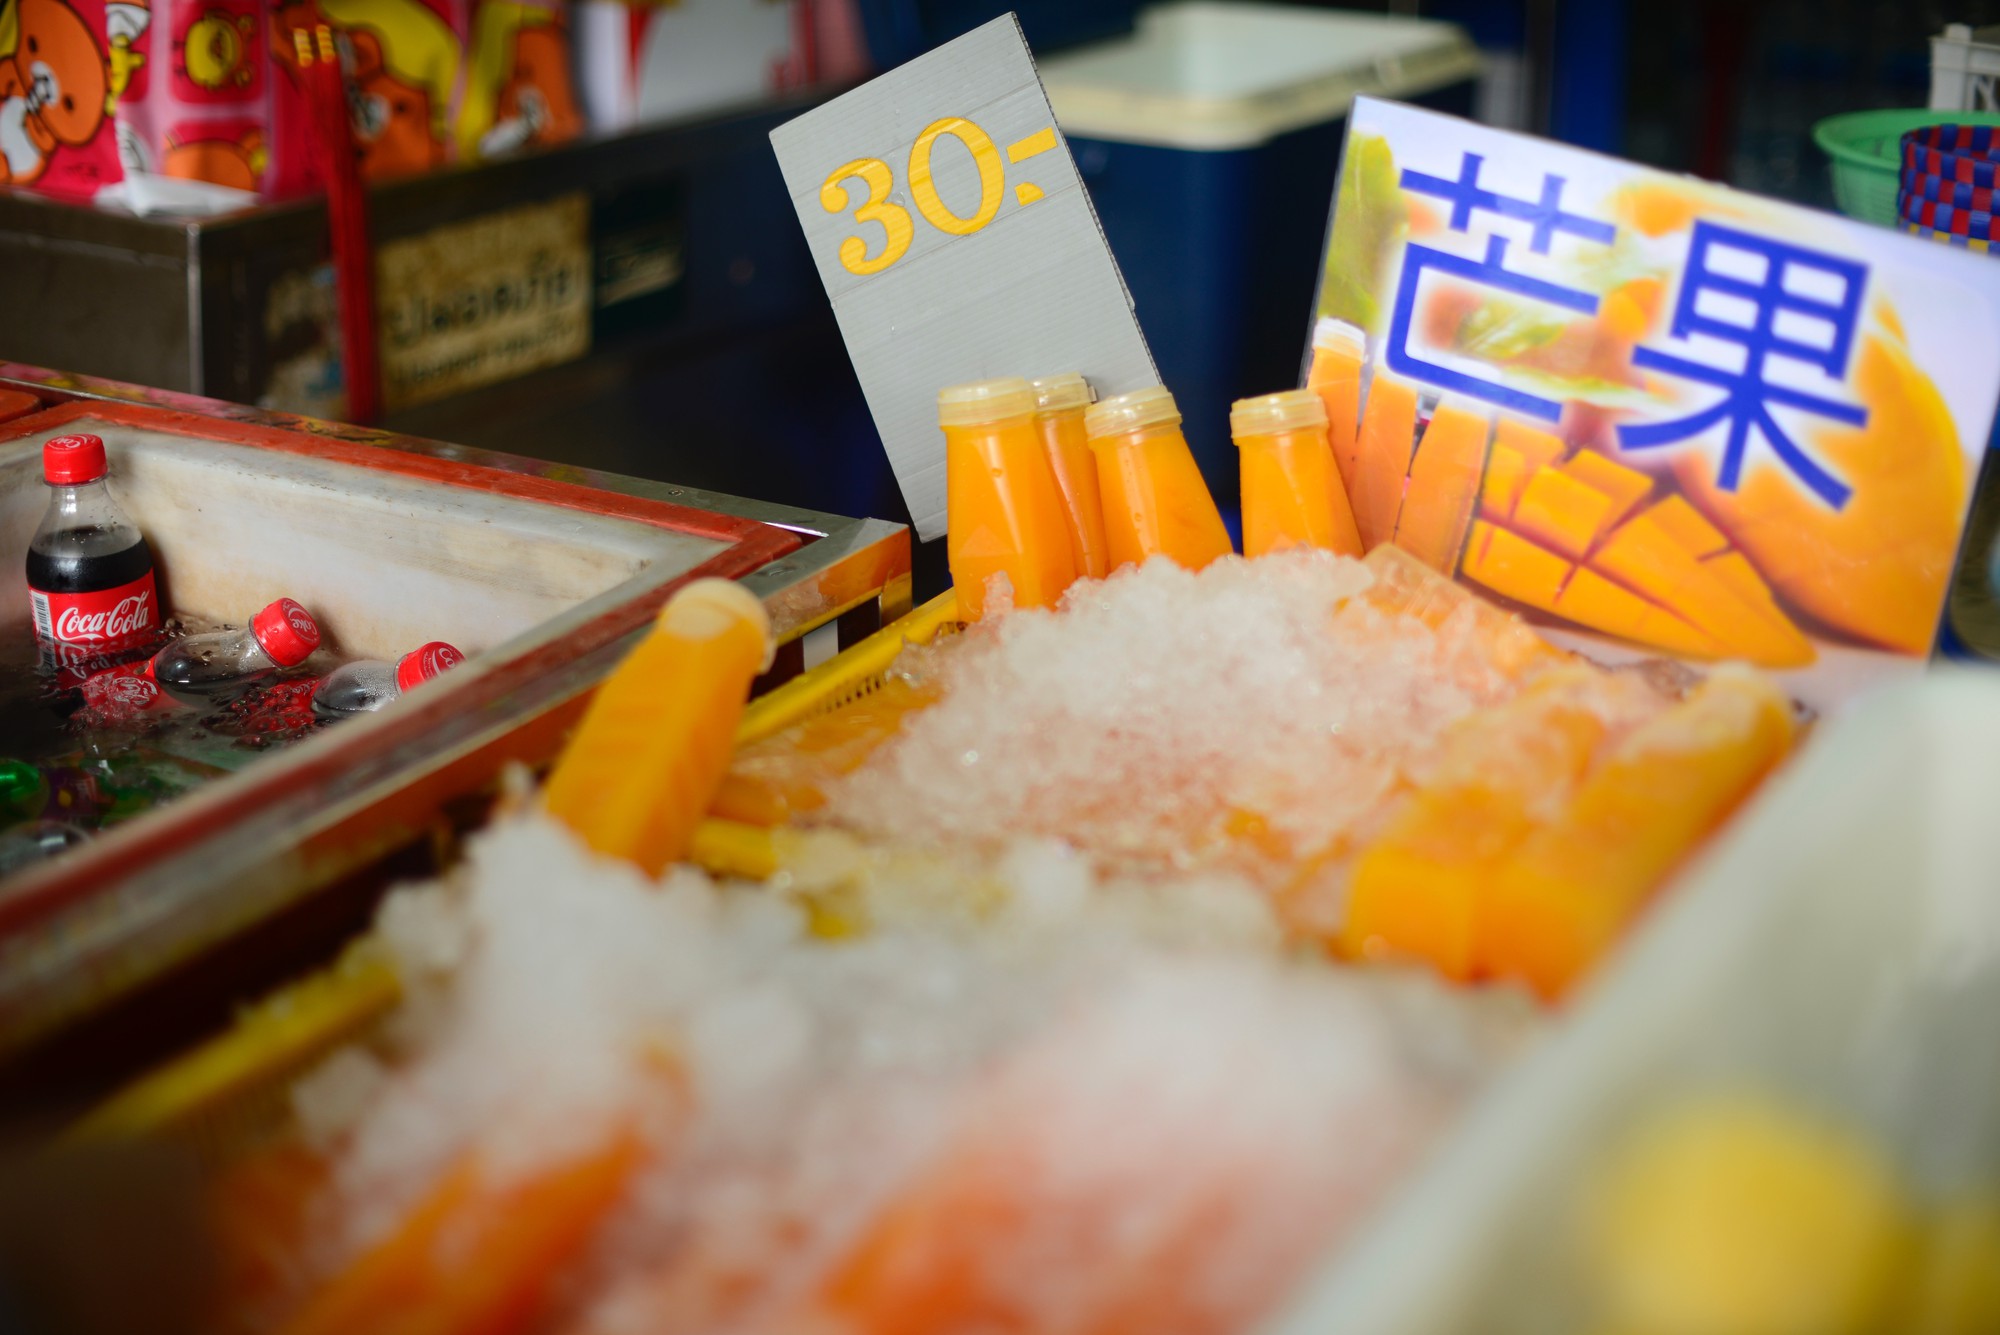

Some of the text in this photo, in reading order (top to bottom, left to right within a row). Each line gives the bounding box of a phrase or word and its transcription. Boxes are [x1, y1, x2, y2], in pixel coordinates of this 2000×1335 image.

[1386, 151, 1870, 513] 芒果
[57, 590, 150, 640] Coca-Cola
[289, 618, 318, 636] Coke
